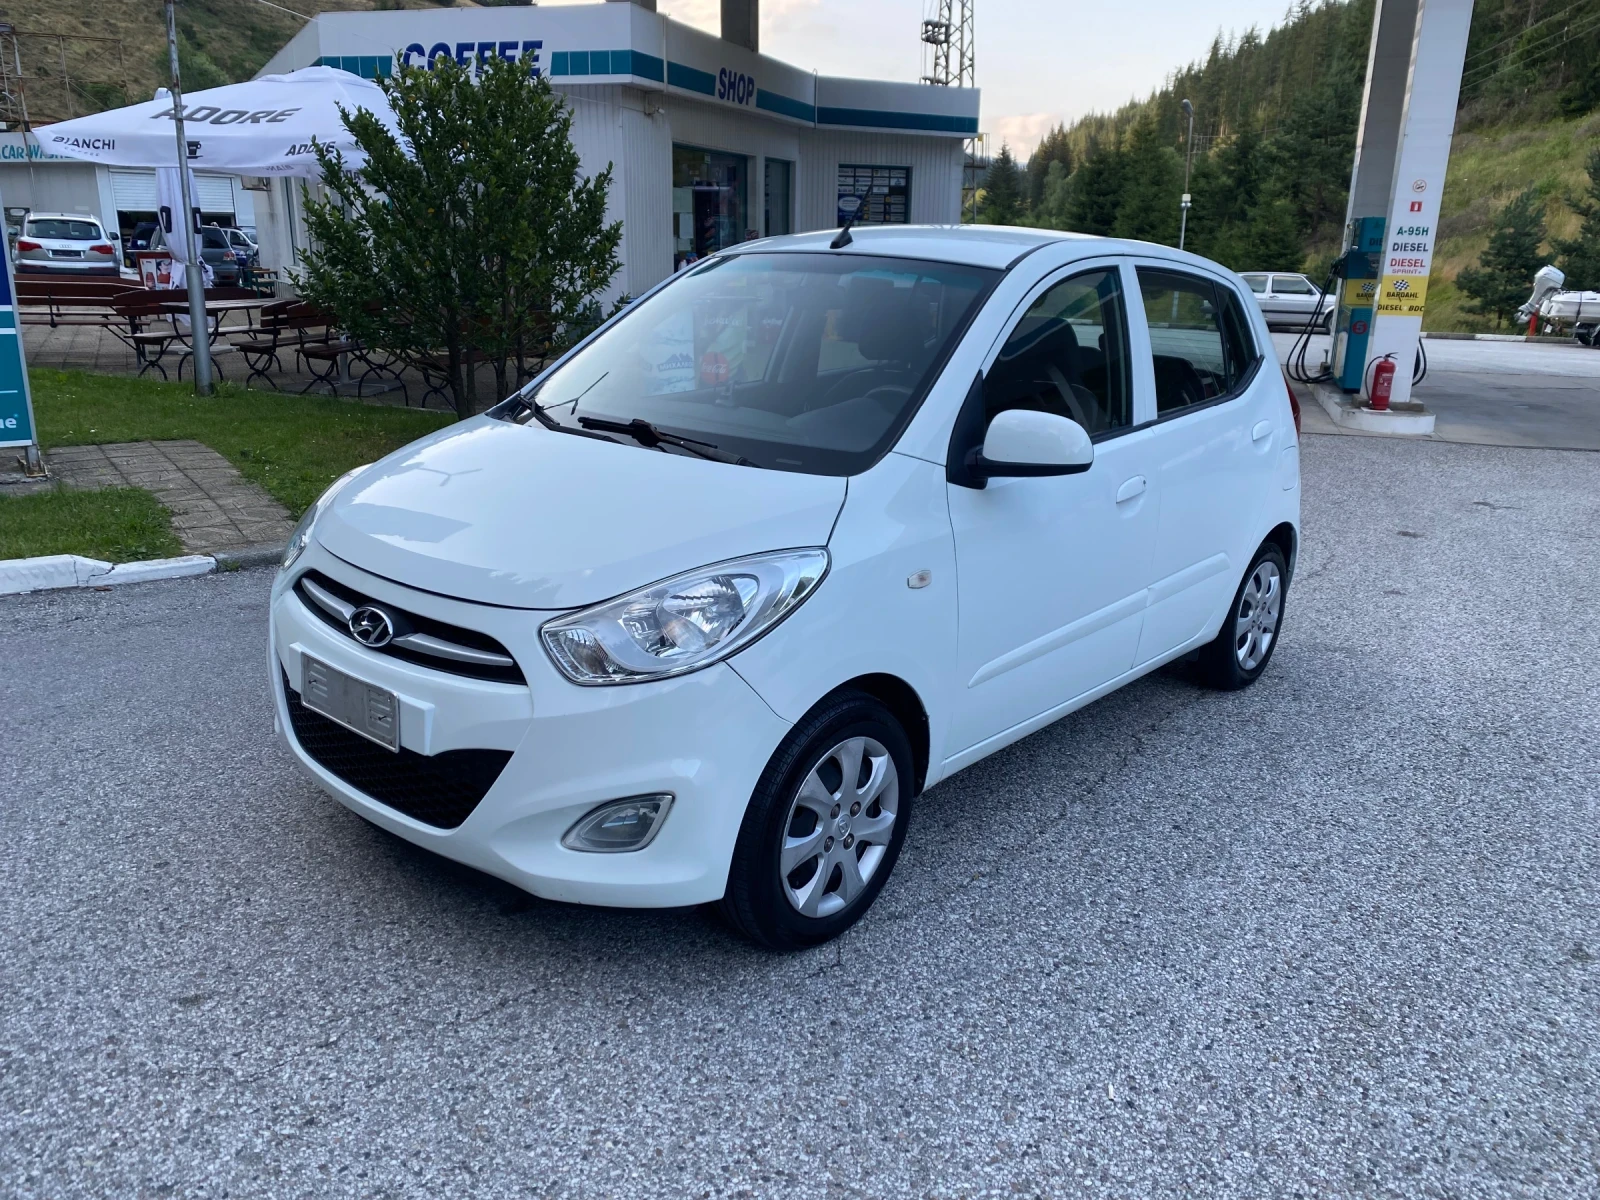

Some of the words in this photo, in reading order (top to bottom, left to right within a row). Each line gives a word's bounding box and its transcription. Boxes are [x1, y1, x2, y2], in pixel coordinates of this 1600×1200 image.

[403, 40, 544, 78] COFFEE
[718, 67, 755, 106] SHOP
[149, 105, 303, 125] ADORE
[52, 135, 115, 150] BIANCHI
[1396, 226, 1429, 236] A-95H
[1392, 242, 1429, 252] DIESEL
[1390, 258, 1426, 268] DIESEL
[1386, 291, 1419, 299] BARDAHL
[1356, 321, 1365, 334] 5
